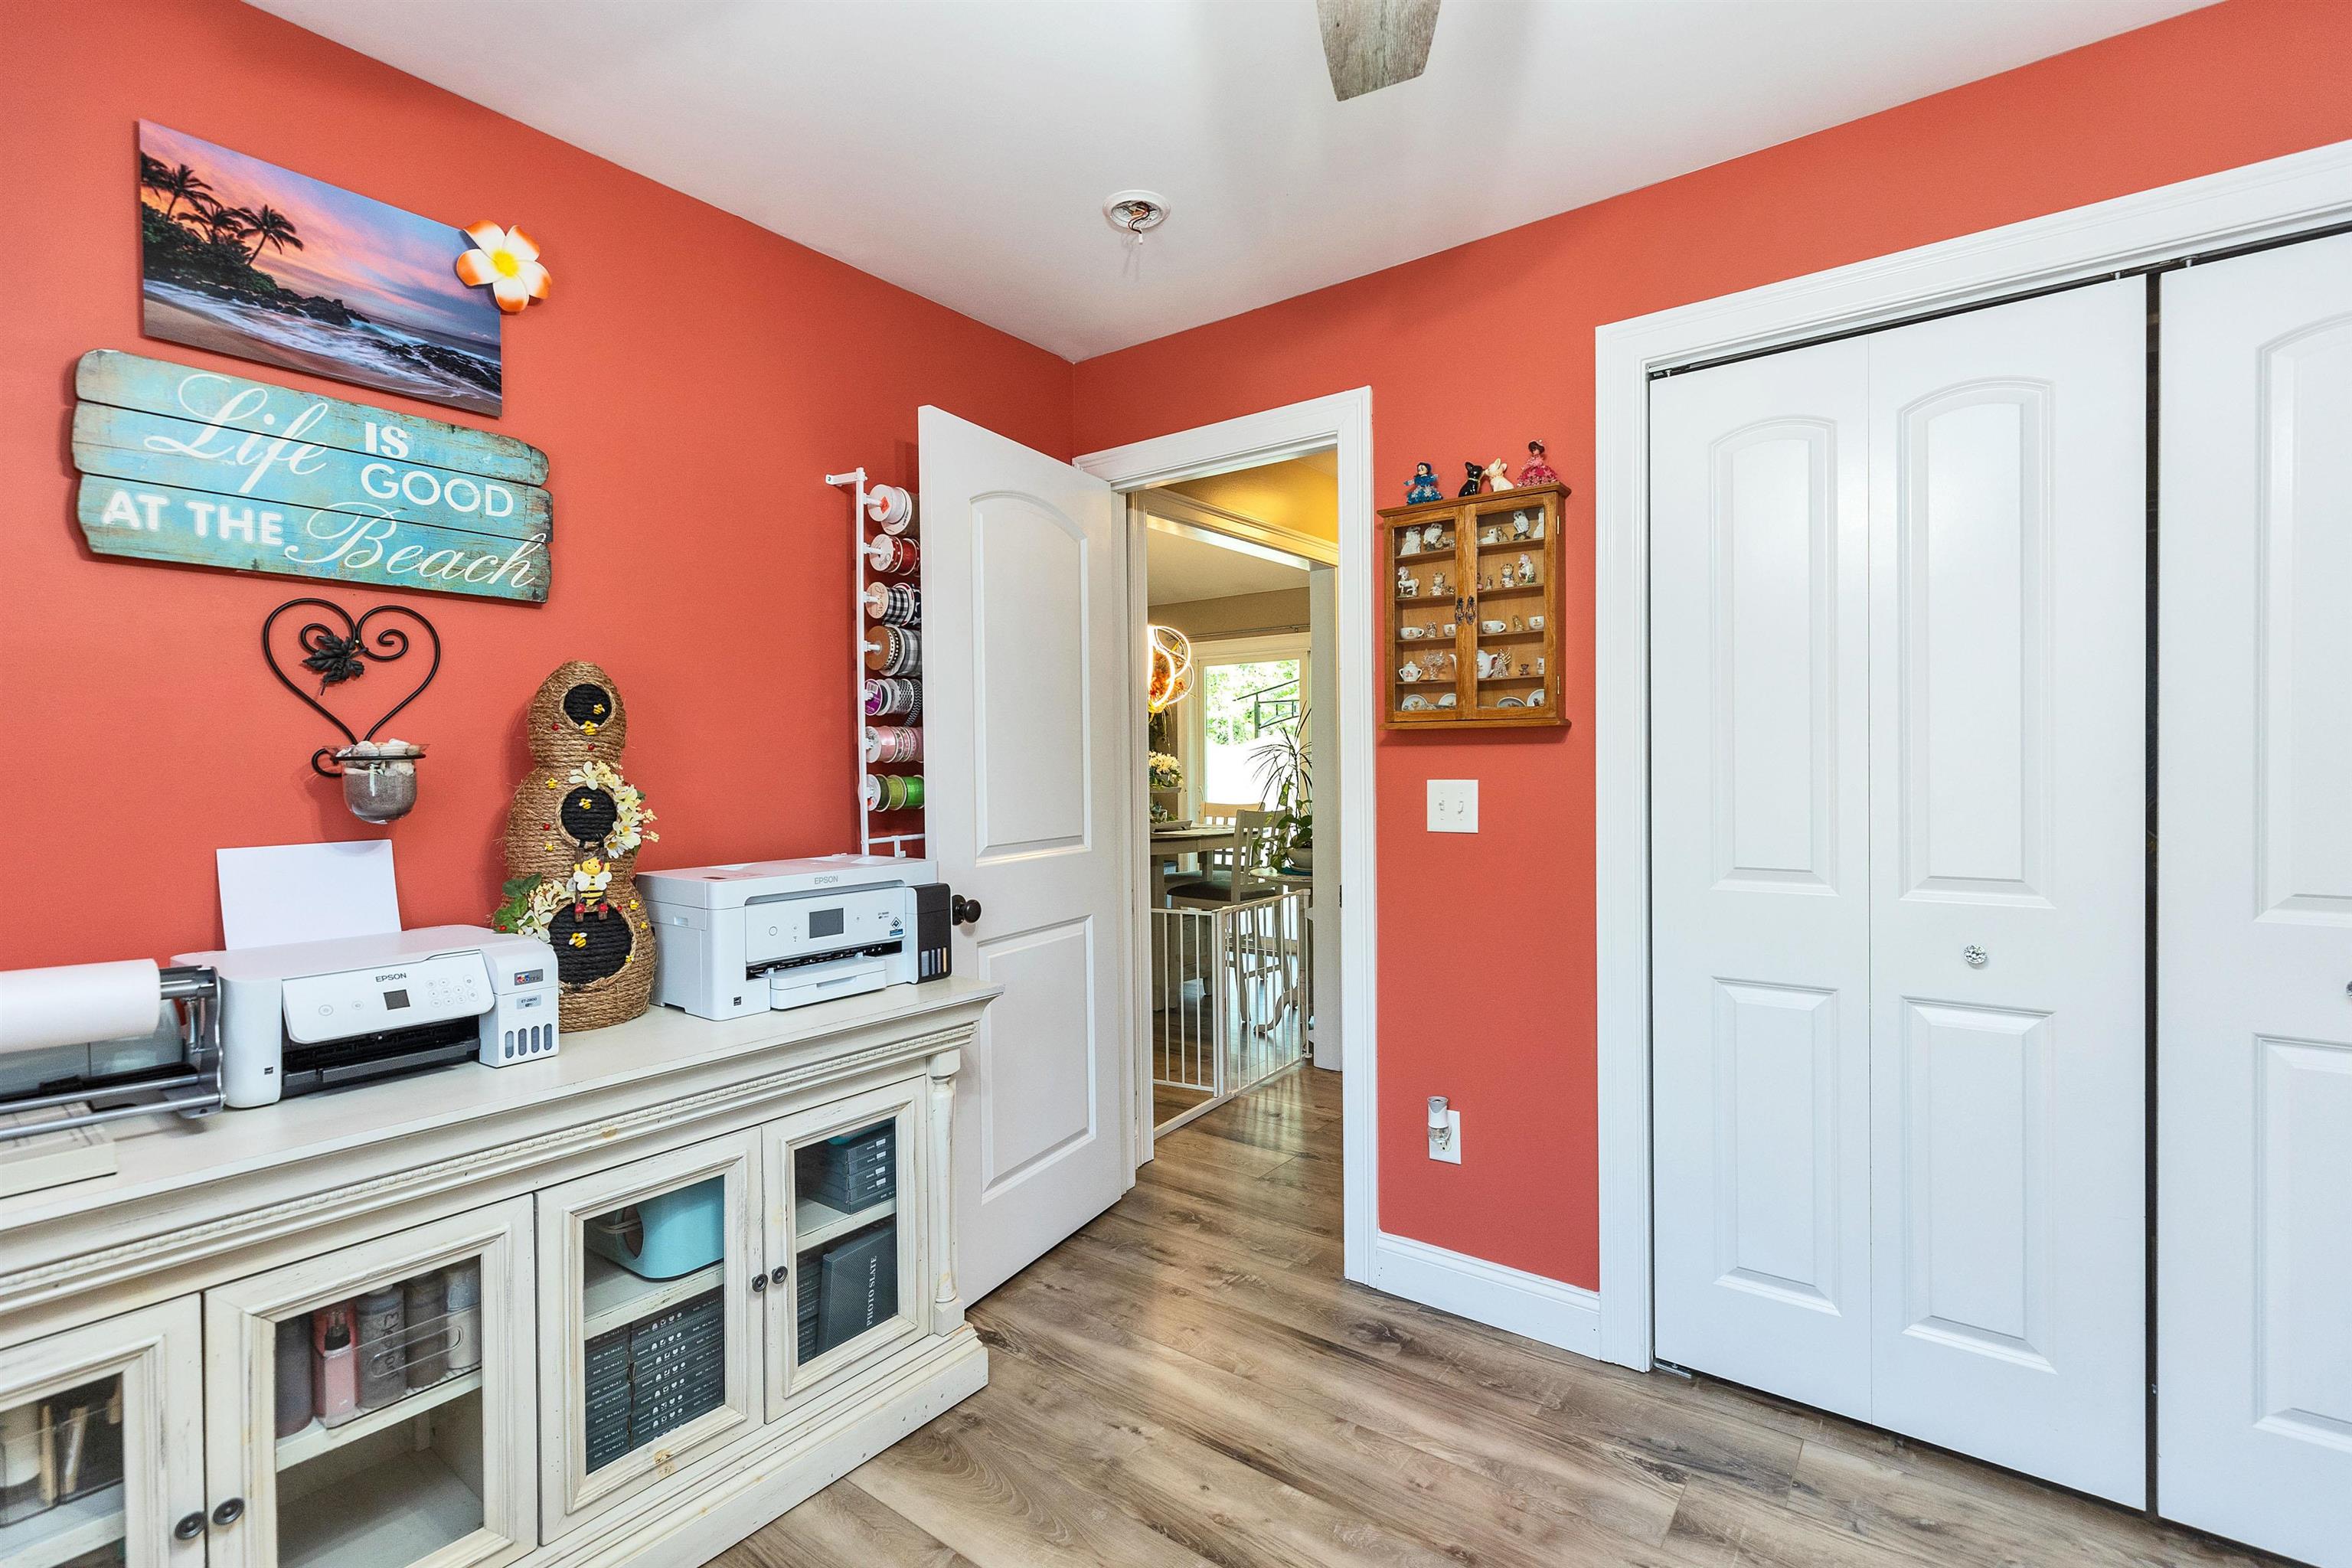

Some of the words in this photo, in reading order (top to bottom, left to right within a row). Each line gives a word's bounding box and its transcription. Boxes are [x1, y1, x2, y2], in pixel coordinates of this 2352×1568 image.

[144, 374, 328, 494] Life
[365, 421, 410, 459] IS
[361, 463, 514, 518] GOOD
[102, 489, 170, 531] AT
[185, 500, 284, 547] THE
[284, 502, 547, 588] Beach
[814, 875, 838, 884] EPSON
[375, 972, 407, 982] EPSON
[869, 1256, 877, 1288] SLATE
